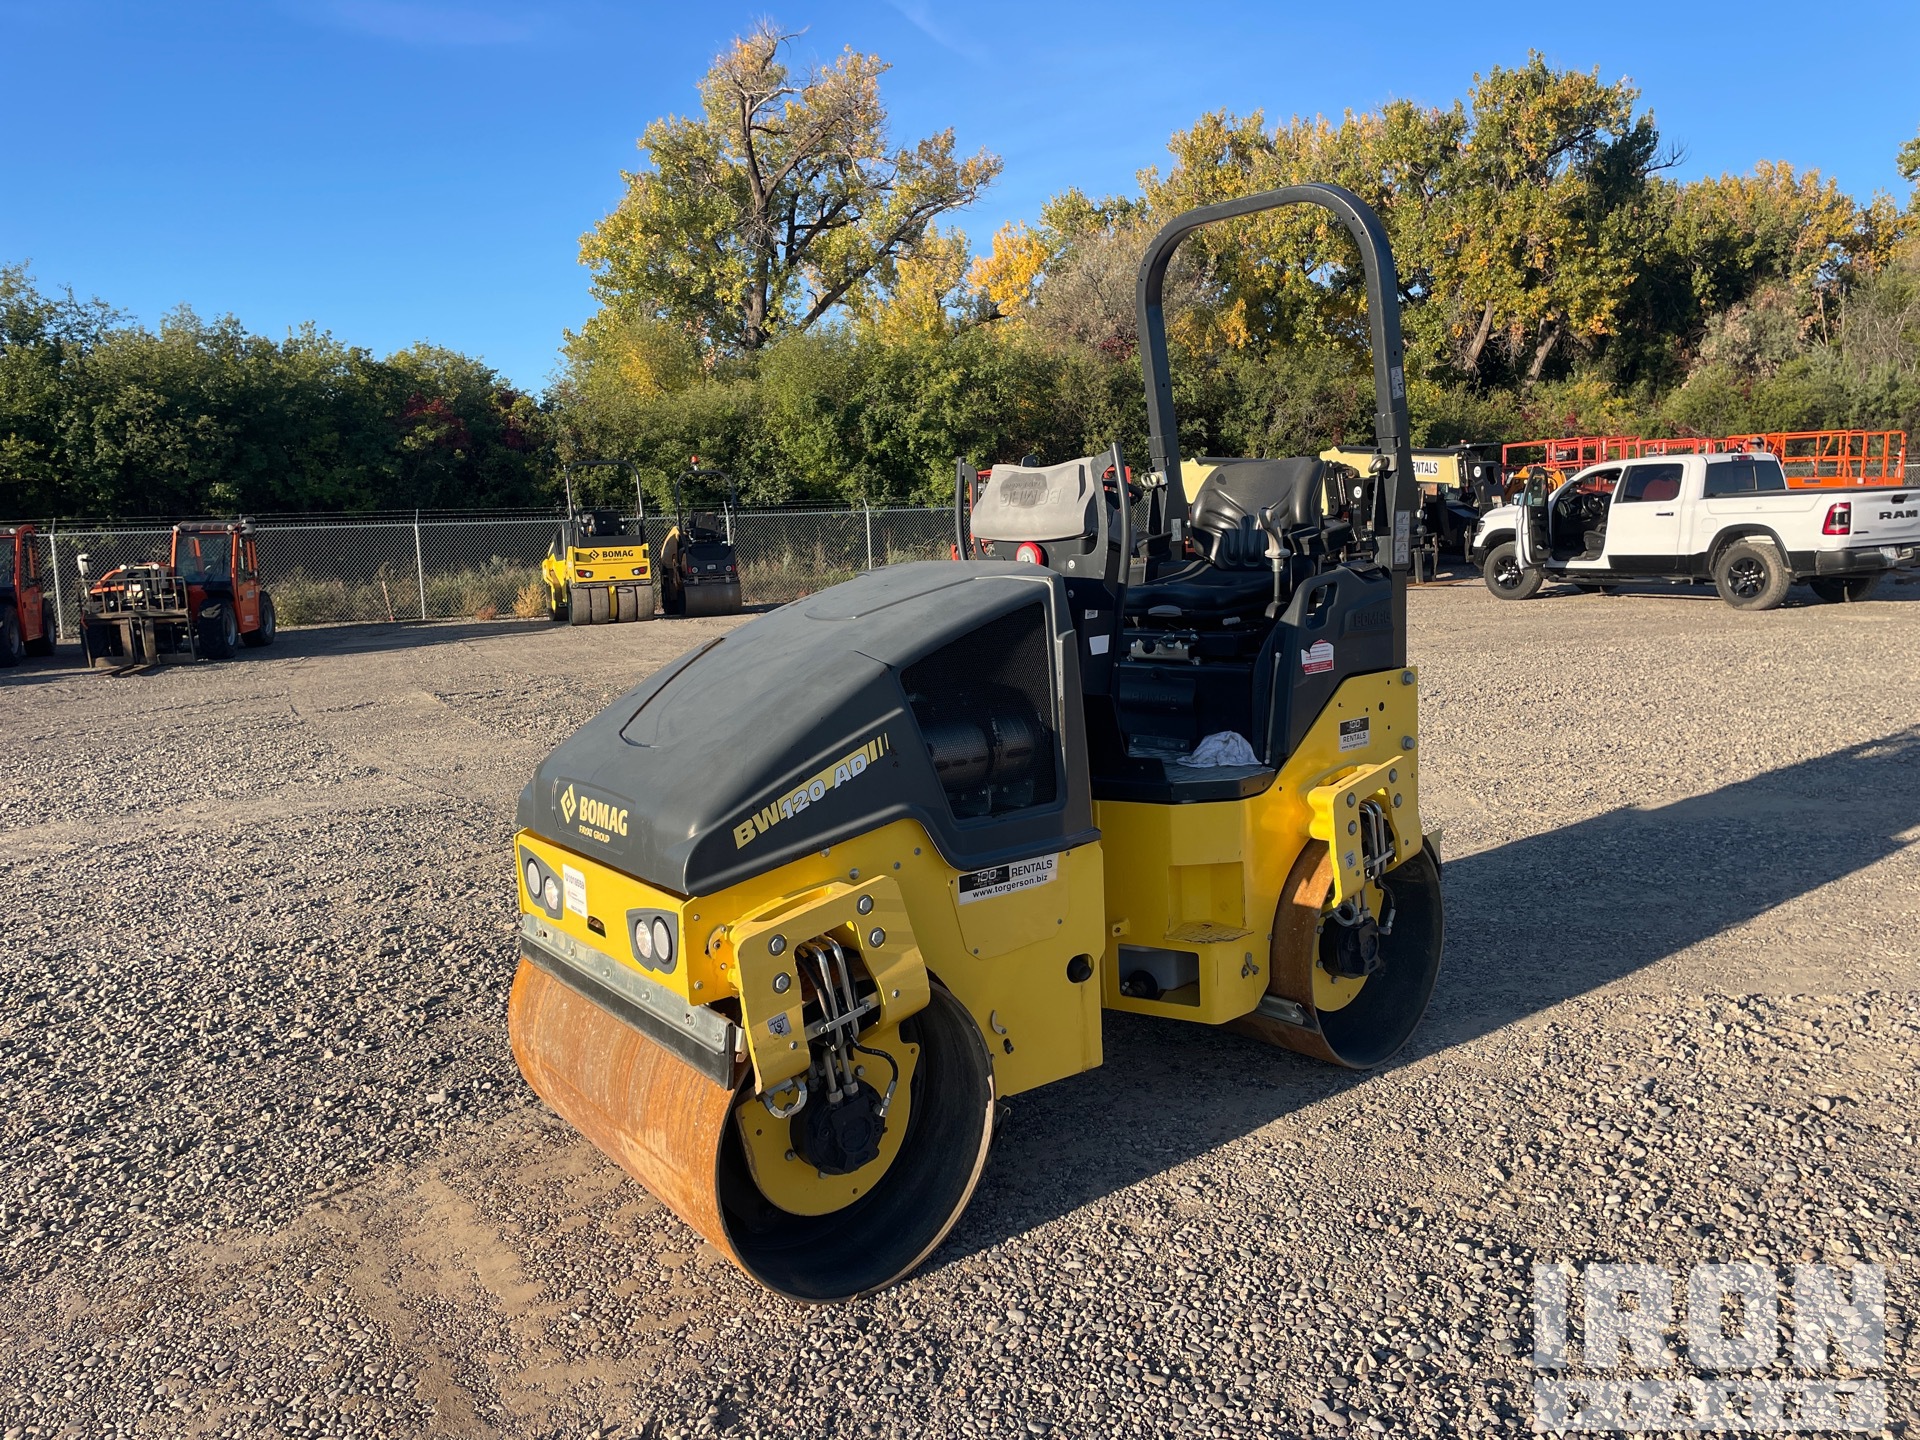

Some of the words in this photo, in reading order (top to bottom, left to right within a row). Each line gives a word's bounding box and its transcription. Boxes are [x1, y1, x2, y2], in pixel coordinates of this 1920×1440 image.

[1412, 461, 1438, 474] ENTALS
[1879, 510, 1918, 520] RAM
[602, 550, 633, 558] BOMAG
[1343, 732, 1366, 743] RENTALS
[834, 753, 868, 789] AD
[579, 795, 628, 837] BOMAG
[593, 830, 610, 843] GROUP
[1011, 860, 1053, 878] RENTALS
[977, 869, 997, 883] 100
[972, 874, 1048, 898] www.torgerson.biz
